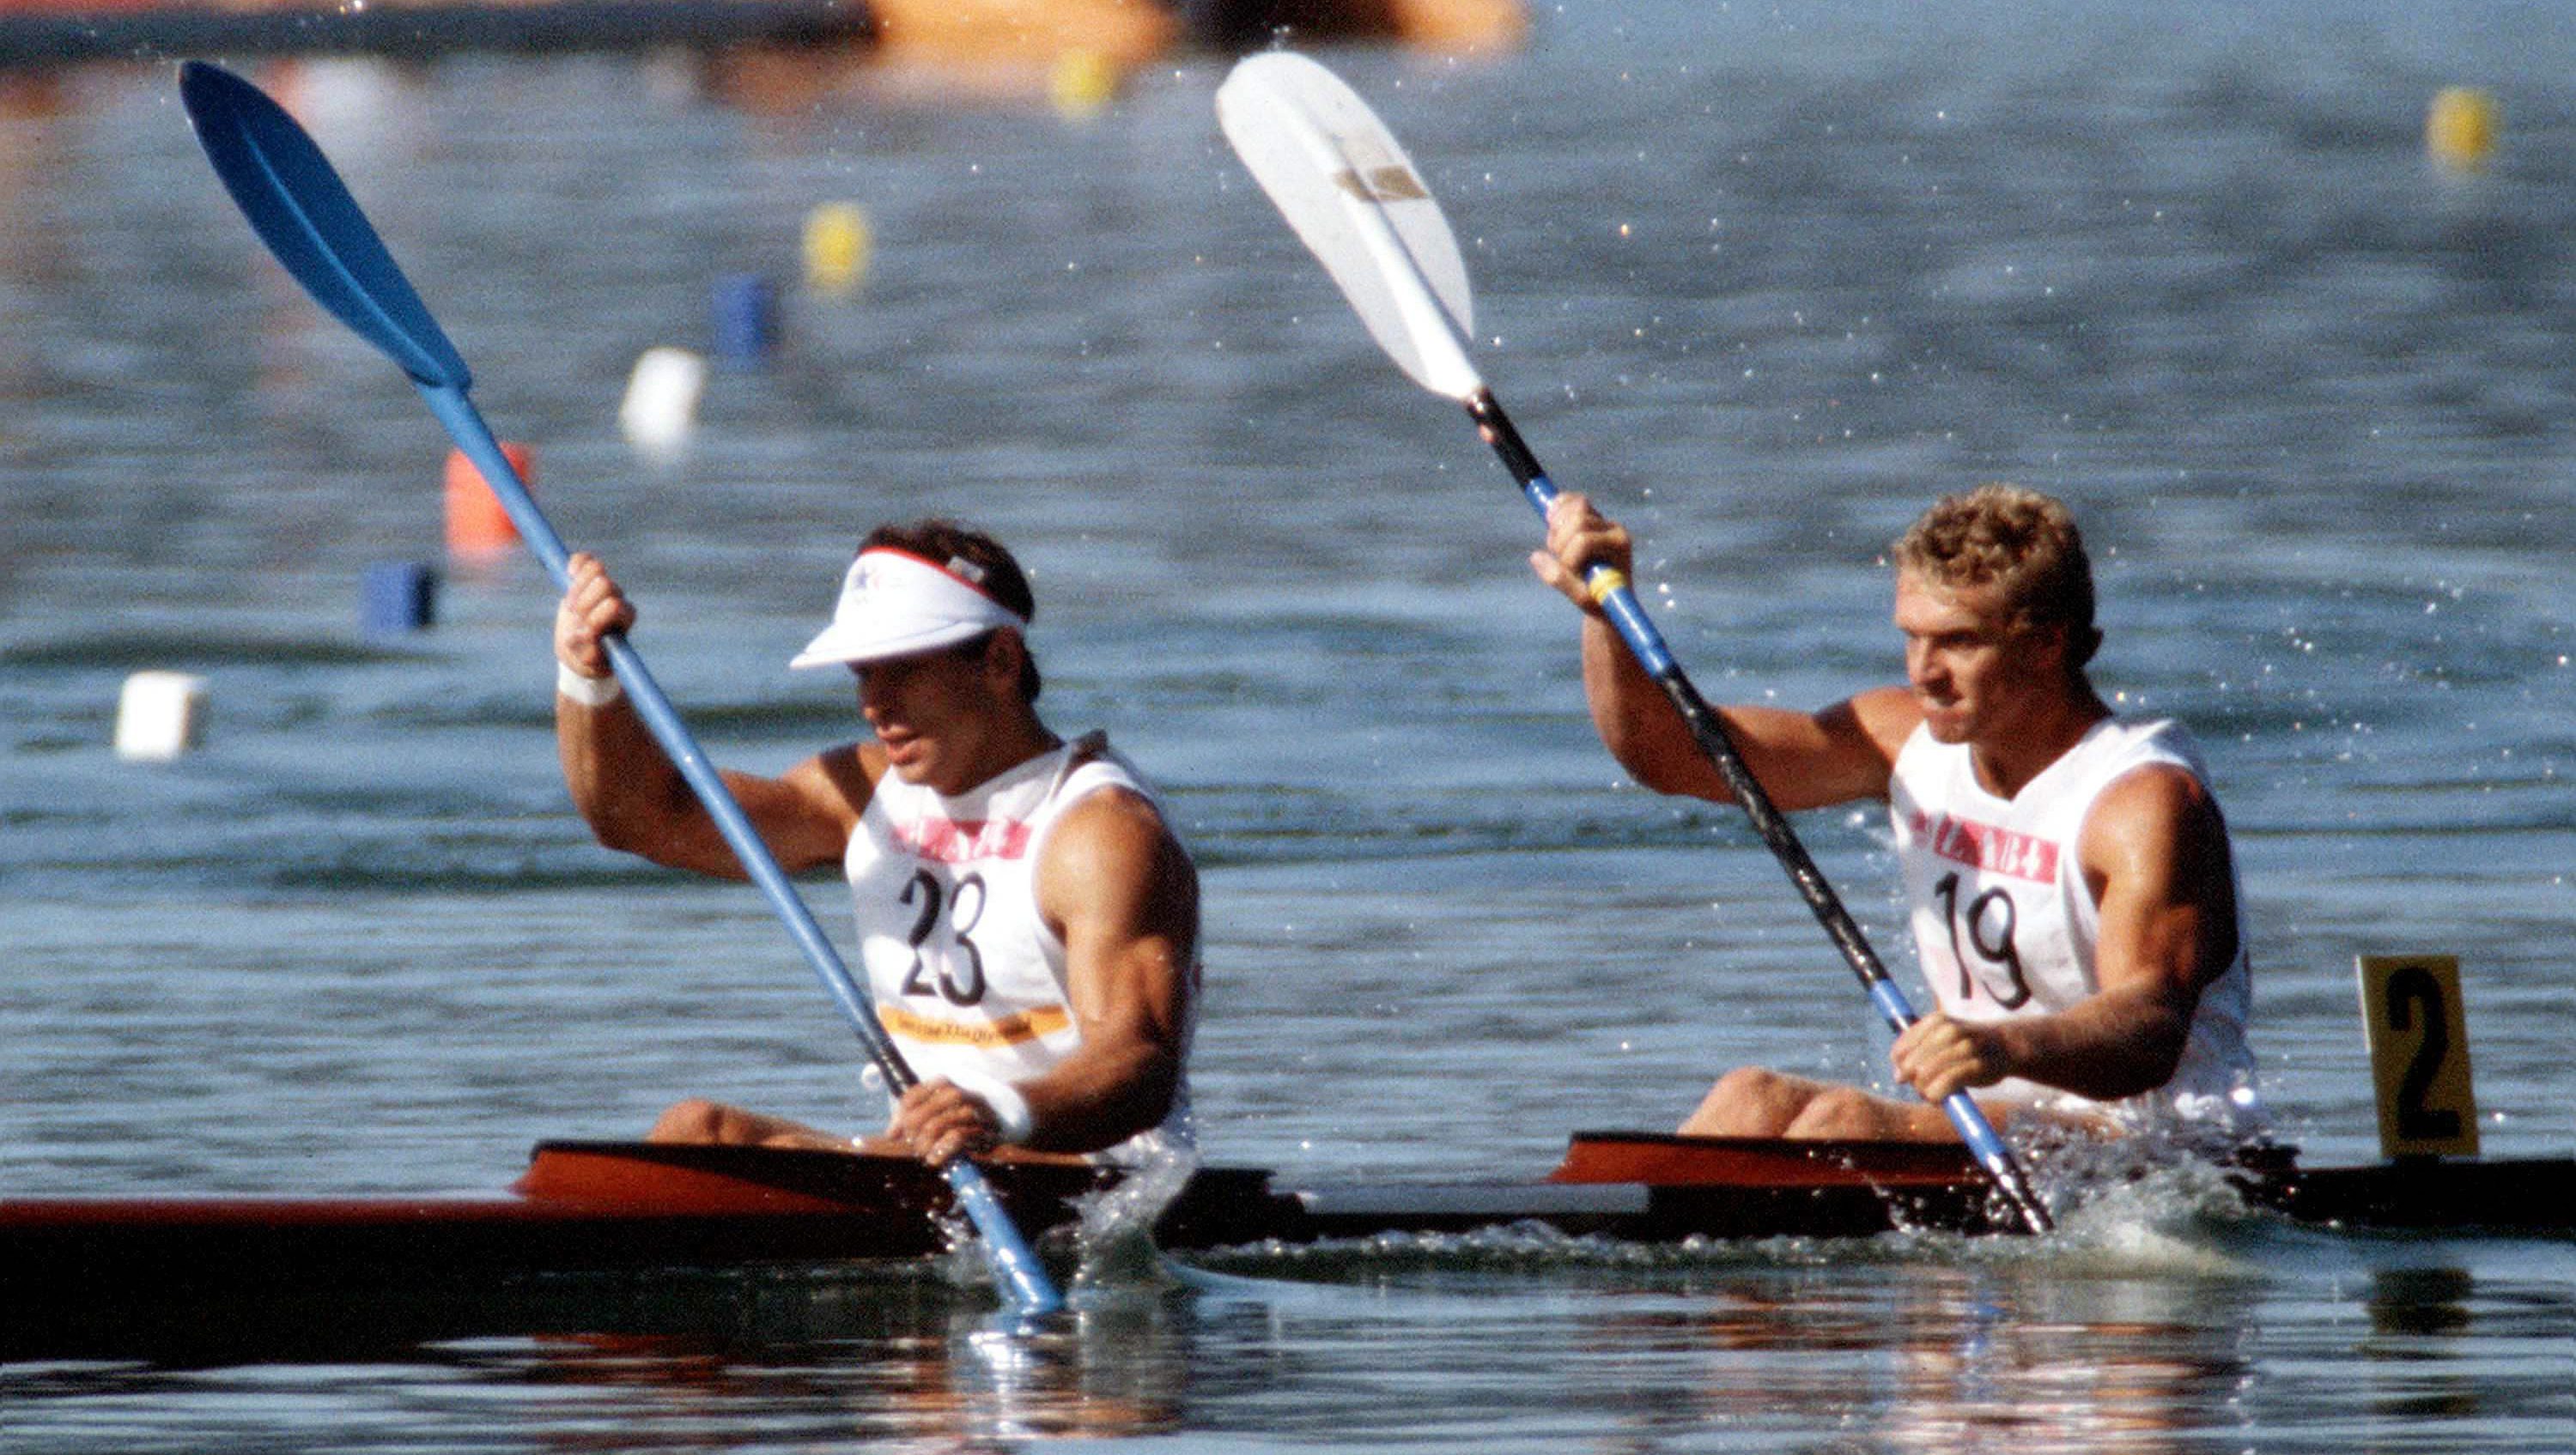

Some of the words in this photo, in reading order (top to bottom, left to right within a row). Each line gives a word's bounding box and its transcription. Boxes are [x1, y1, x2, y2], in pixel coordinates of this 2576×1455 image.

[900, 867, 987, 1006] 23
[1935, 871, 2032, 1011] 19
[2386, 966, 2461, 1141] 2
